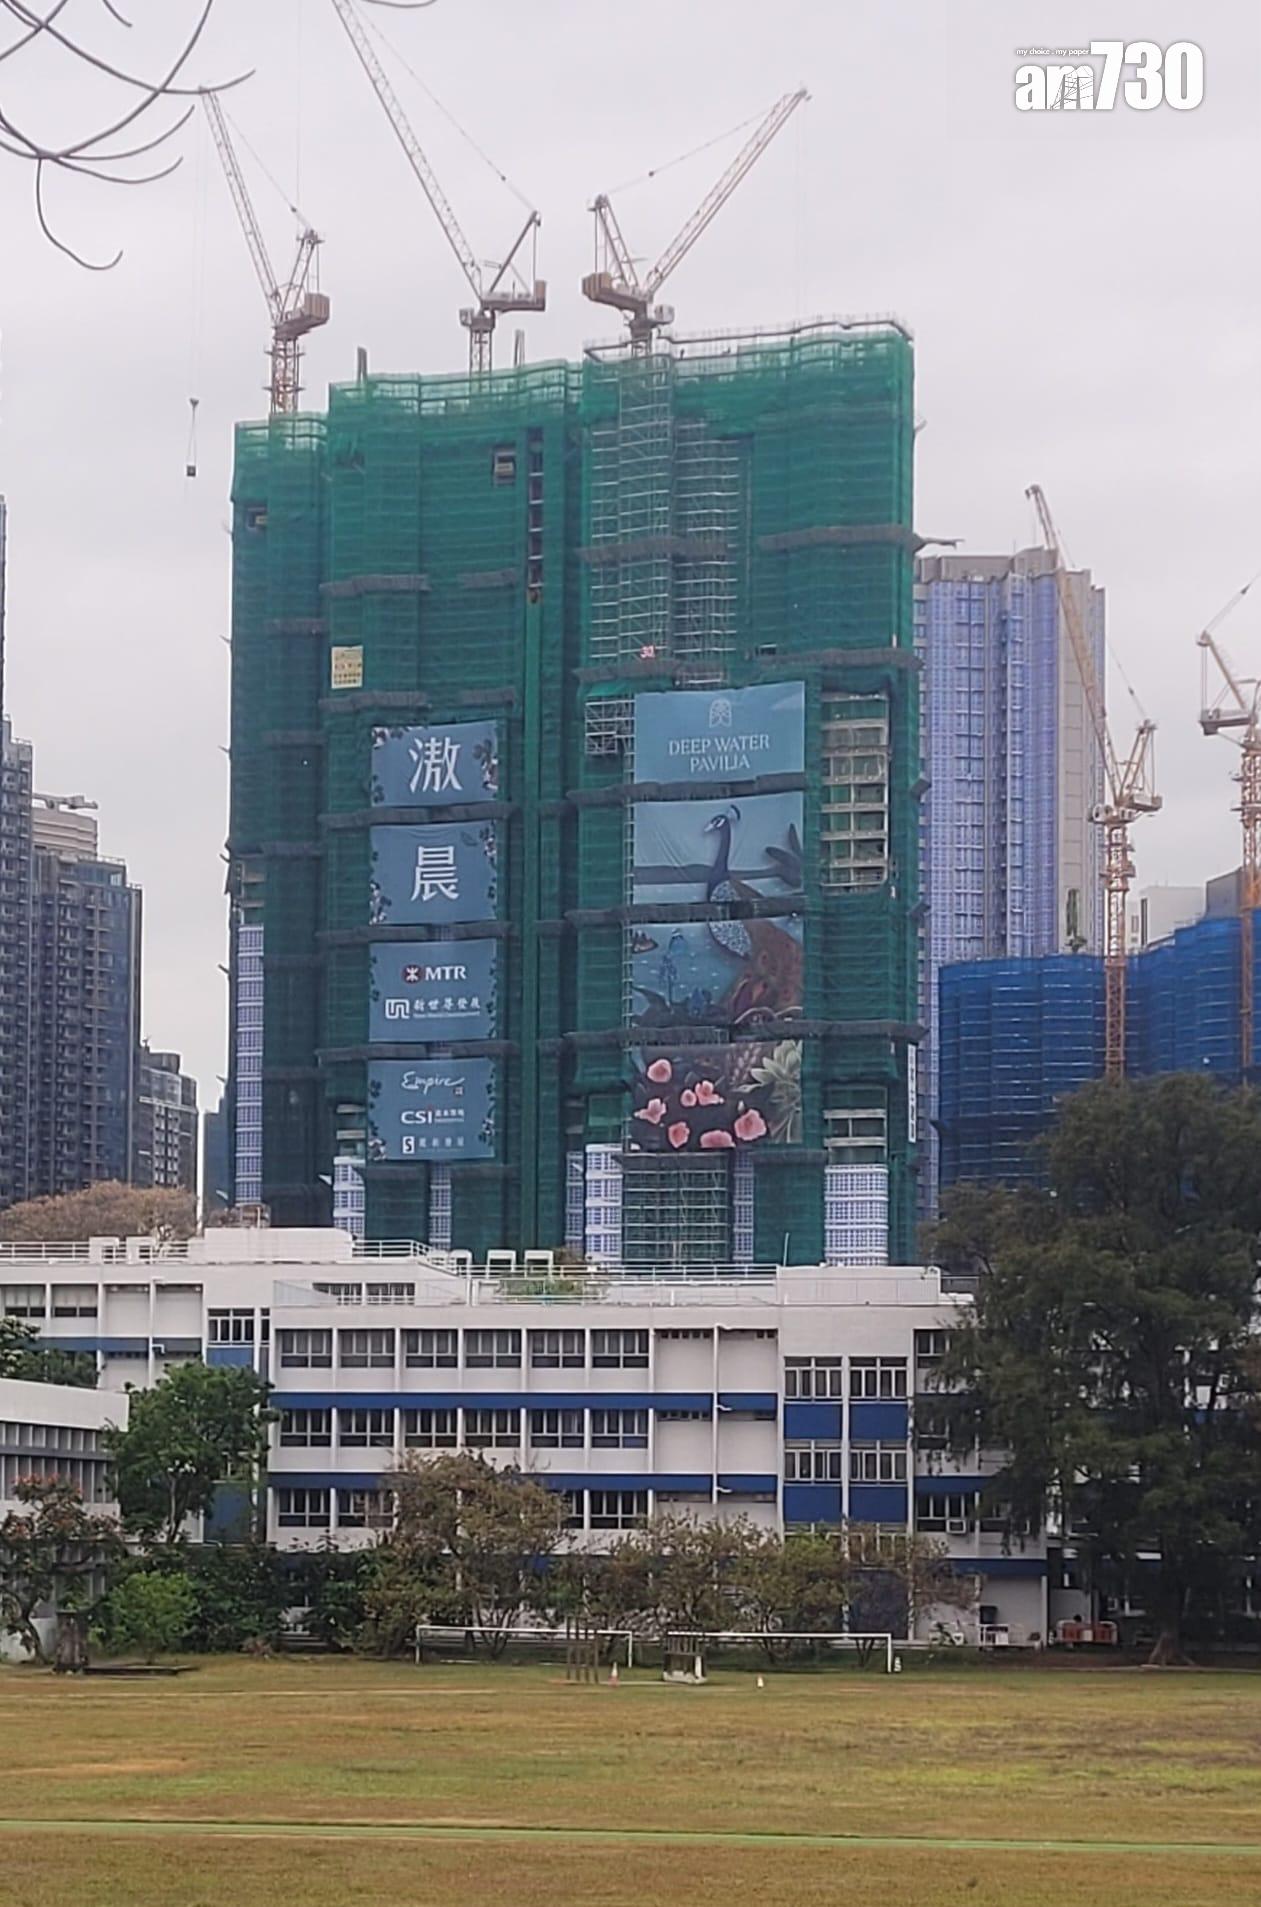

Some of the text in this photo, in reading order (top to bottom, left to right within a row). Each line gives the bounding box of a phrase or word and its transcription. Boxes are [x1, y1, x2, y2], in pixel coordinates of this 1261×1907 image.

[668, 733, 770, 756] DEEP WATER
[690, 754, 750, 773] PAVILIA
[411, 846, 460, 901] 晨
[425, 965, 467, 981] MTR
[401, 1071, 465, 1095] Empire
